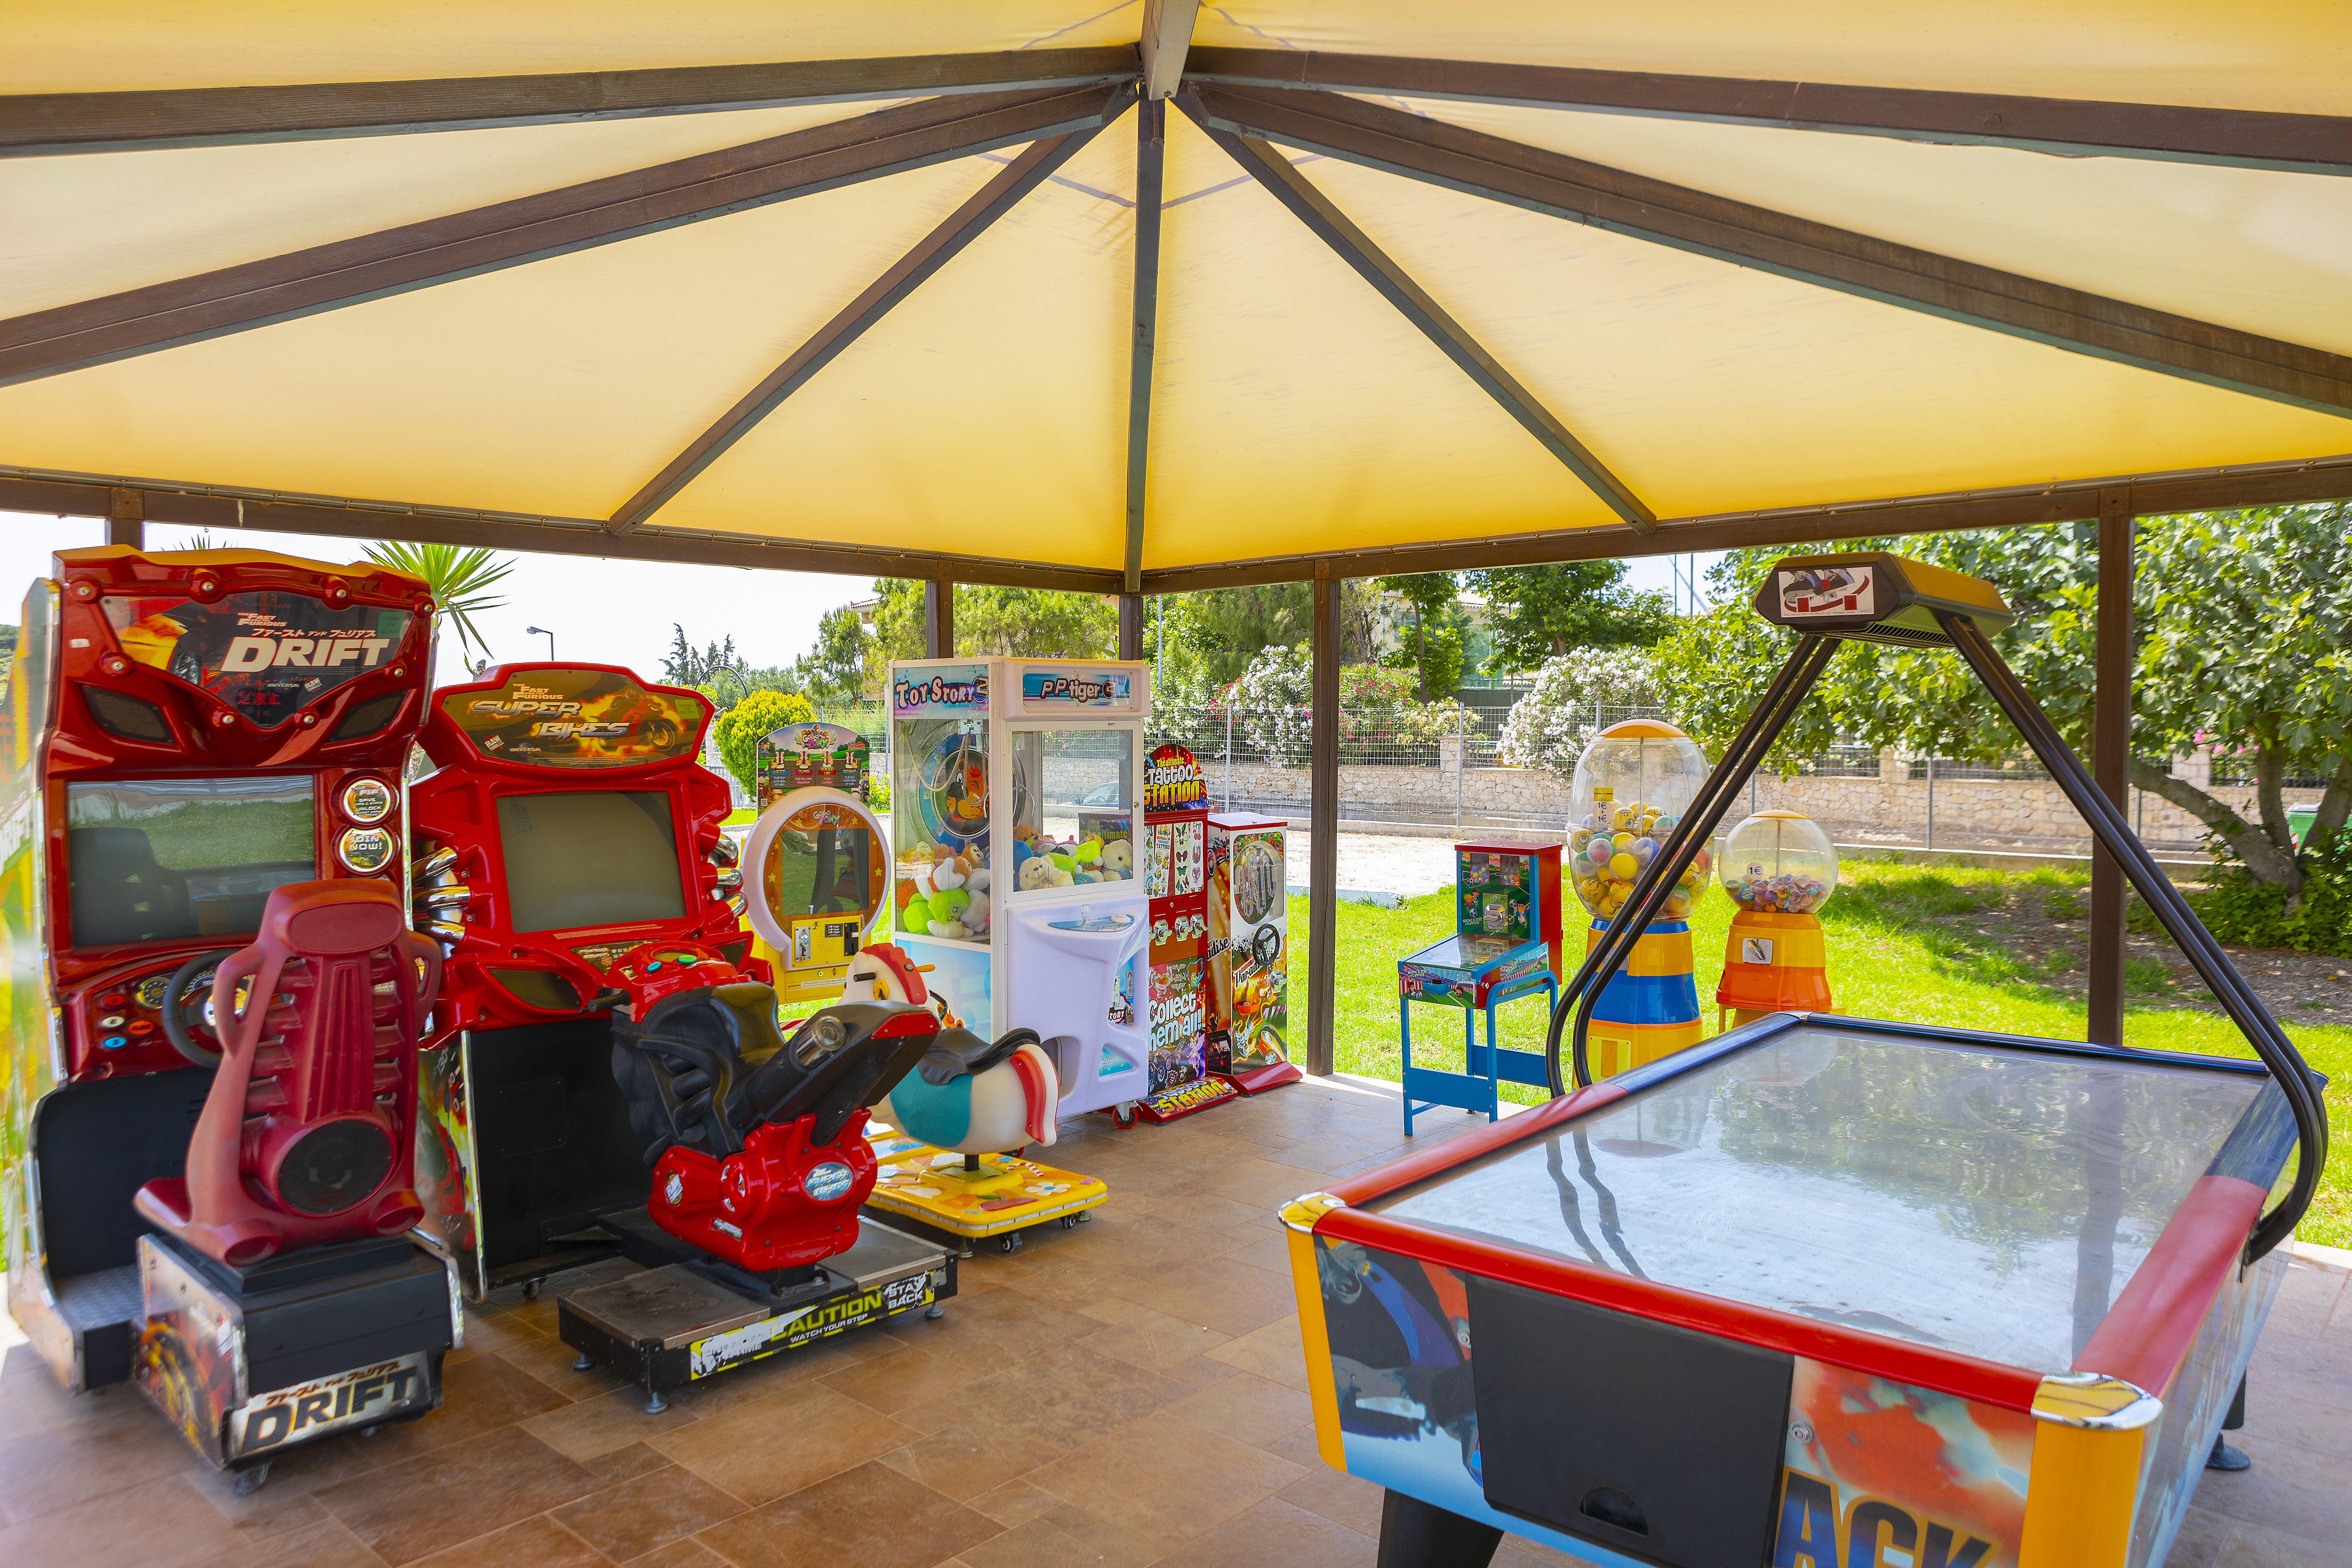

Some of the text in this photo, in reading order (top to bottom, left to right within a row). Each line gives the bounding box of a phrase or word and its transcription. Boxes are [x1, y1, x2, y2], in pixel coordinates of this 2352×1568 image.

[237, 618, 287, 626] FURIOUS
[251, 628, 305, 637] ファースト
[330, 630, 376, 638] フュリアス
[220, 636, 390, 672] DRIFT
[304, 677, 321, 688] RAW
[1069, 679, 1101, 703] tiger
[512, 691, 564, 700] FURIOUS
[895, 680, 929, 709] TOY
[930, 676, 975, 703] STORY
[471, 701, 583, 717] SUPER
[538, 722, 630, 739] BIKES
[485, 735, 502, 748] RAW
[488, 741, 505, 751] THRILLS
[808, 739, 829, 749] PONY
[1157, 757, 1184, 768] The ultimate
[1148, 764, 1193, 786] Tattoo
[1144, 780, 1200, 807] STATION
[813, 810, 831, 819] GOGO
[819, 815, 840, 826] PONY
[350, 842, 383, 851] NOW!
[1749, 866, 1762, 875] 1€
[1208, 938, 1230, 959] adise
[1109, 1011, 1125, 1020] TORY
[1149, 993, 1196, 1027] Collect
[1149, 1008, 1202, 1052] hem all!
[1158, 1081, 1229, 1113] STATION
[808, 1169, 848, 1187] SUPER
[813, 1178, 850, 1196] BIKES
[888, 1281, 920, 1298] STAY
[888, 1290, 924, 1310] BACK
[769, 1293, 883, 1343] CAUTION
[790, 1313, 868, 1343] WATCH YOUR STEP
[241, 1365, 417, 1452] DRIFT
